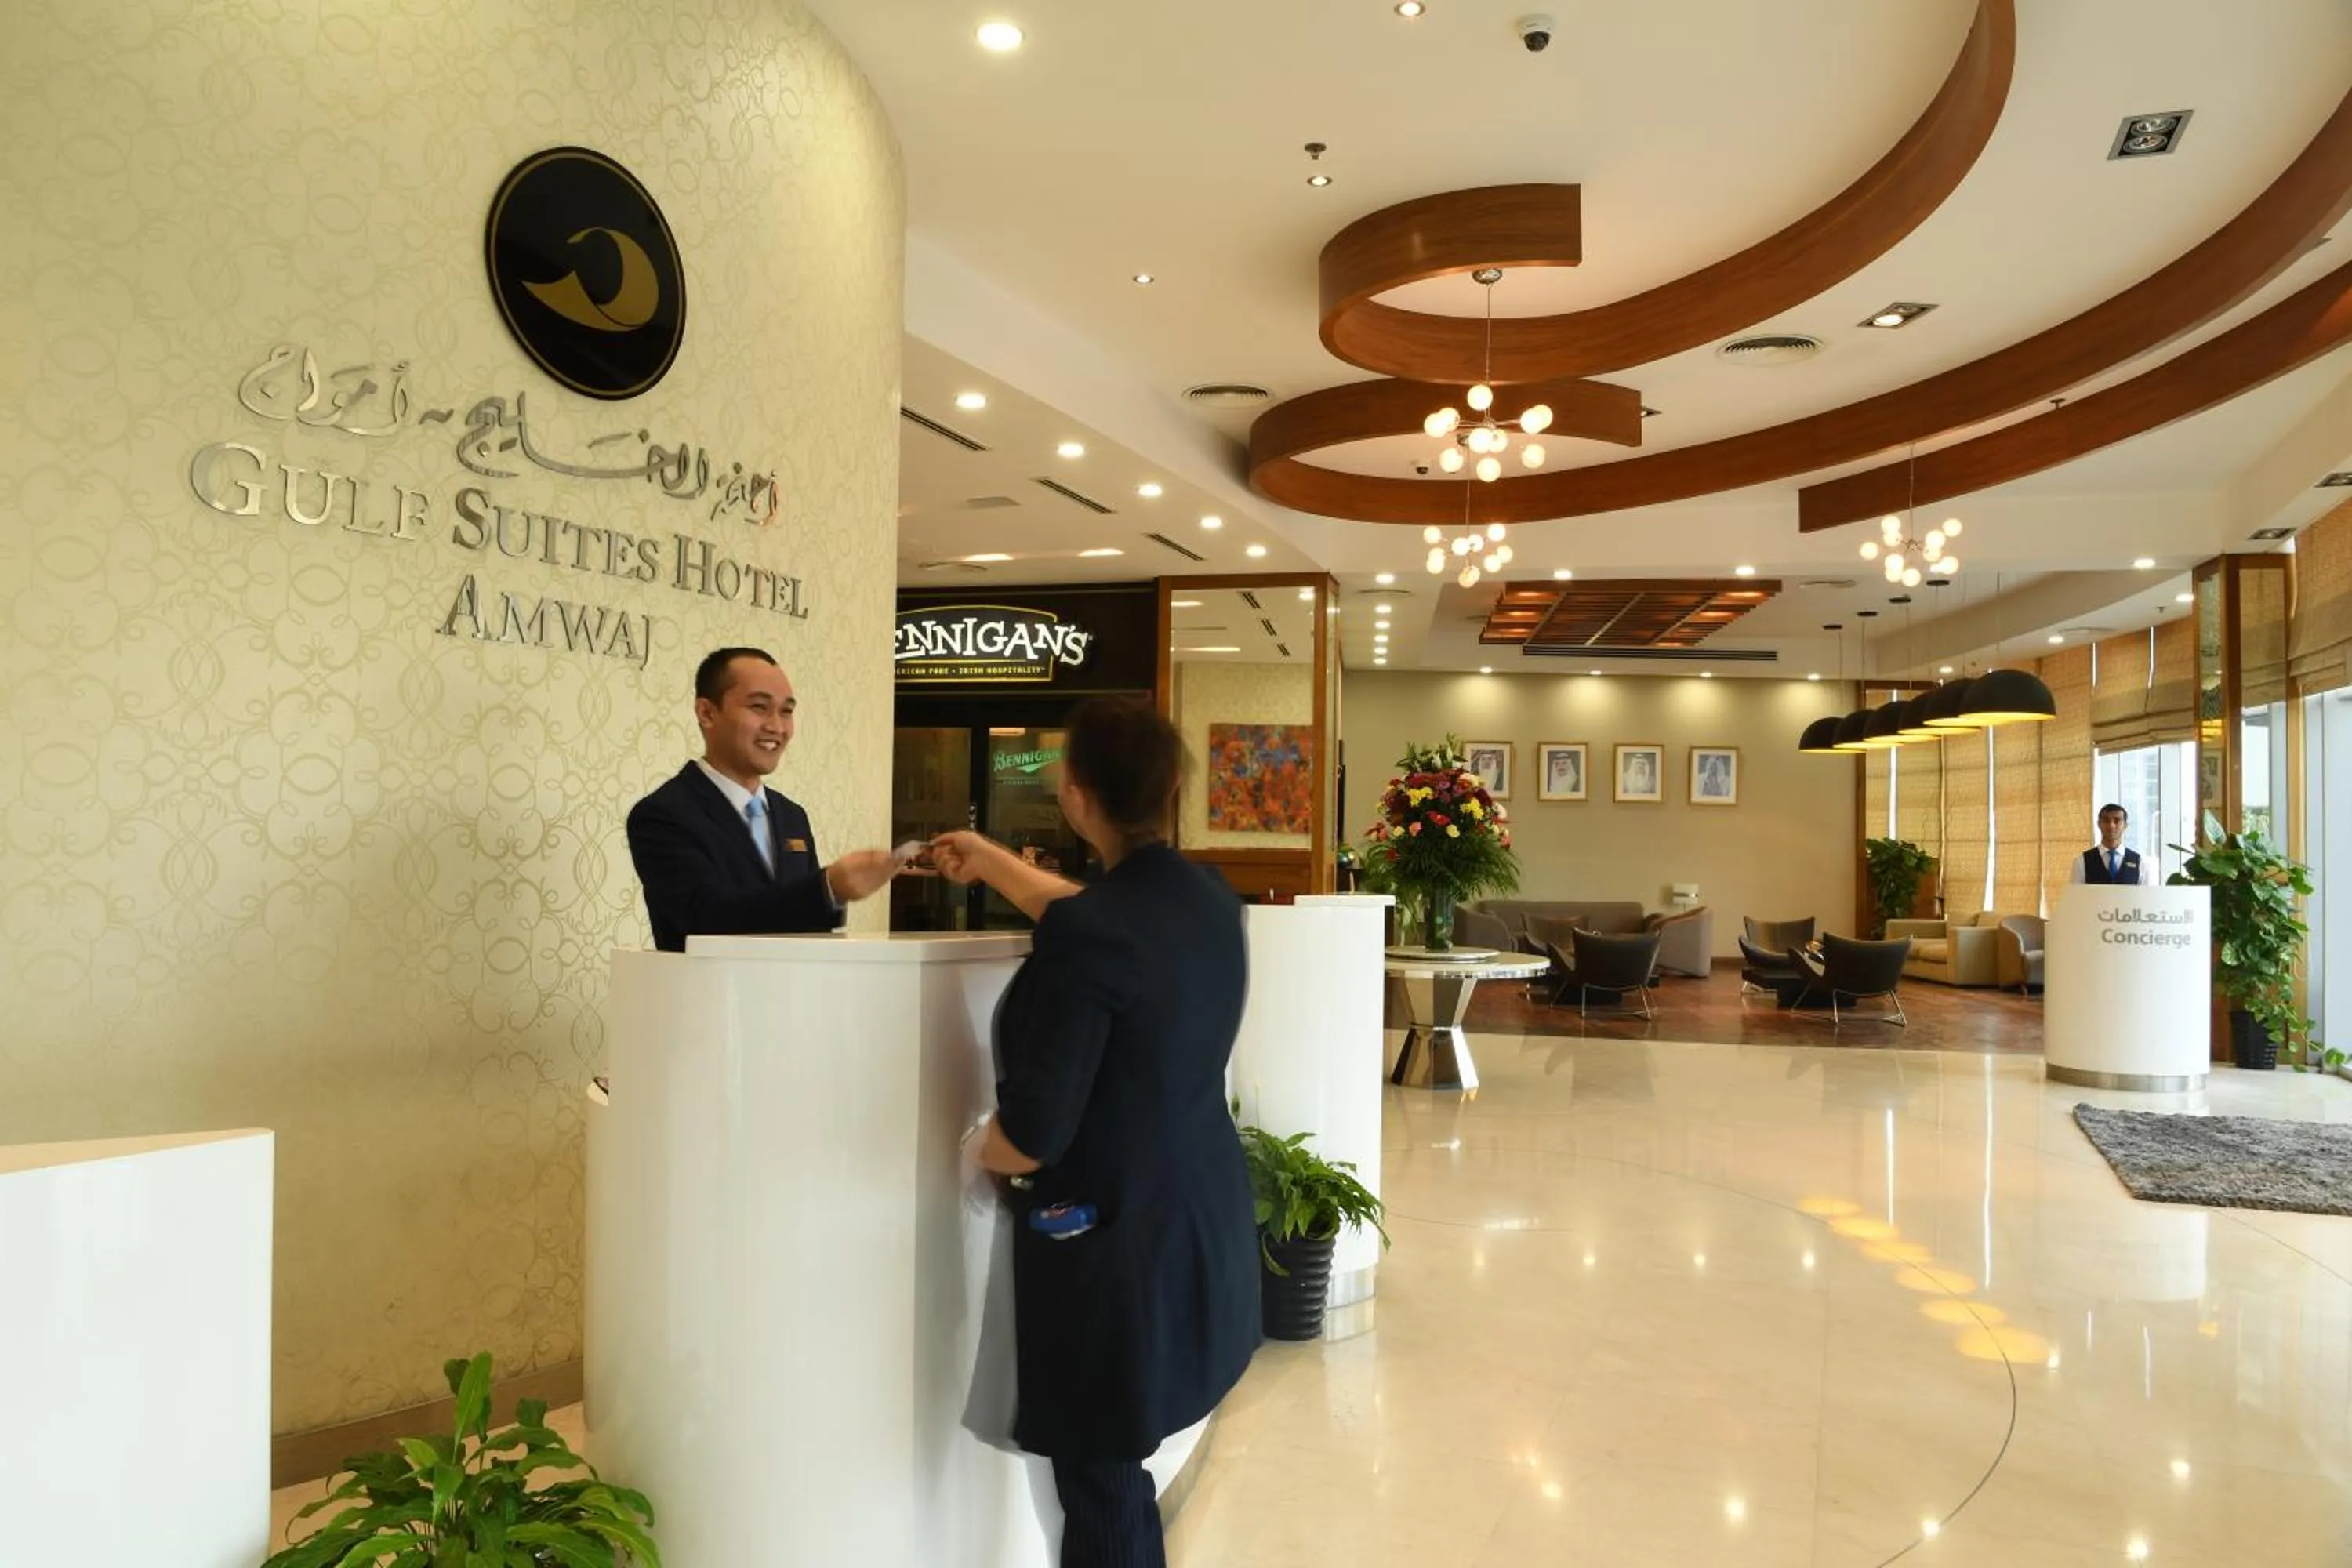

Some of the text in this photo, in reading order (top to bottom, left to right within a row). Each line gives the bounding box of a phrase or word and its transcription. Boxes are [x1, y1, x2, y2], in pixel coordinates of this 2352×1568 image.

[238, 346, 410, 436] أمواج
[457, 391, 709, 500] الخليج
[191, 442, 808, 620] GULF SUITES HOTEL
[435, 575, 651, 671] AMWAJ
[2097, 908, 2194, 924] الاستعلامات
[2102, 928, 2192, 949] Concierge
